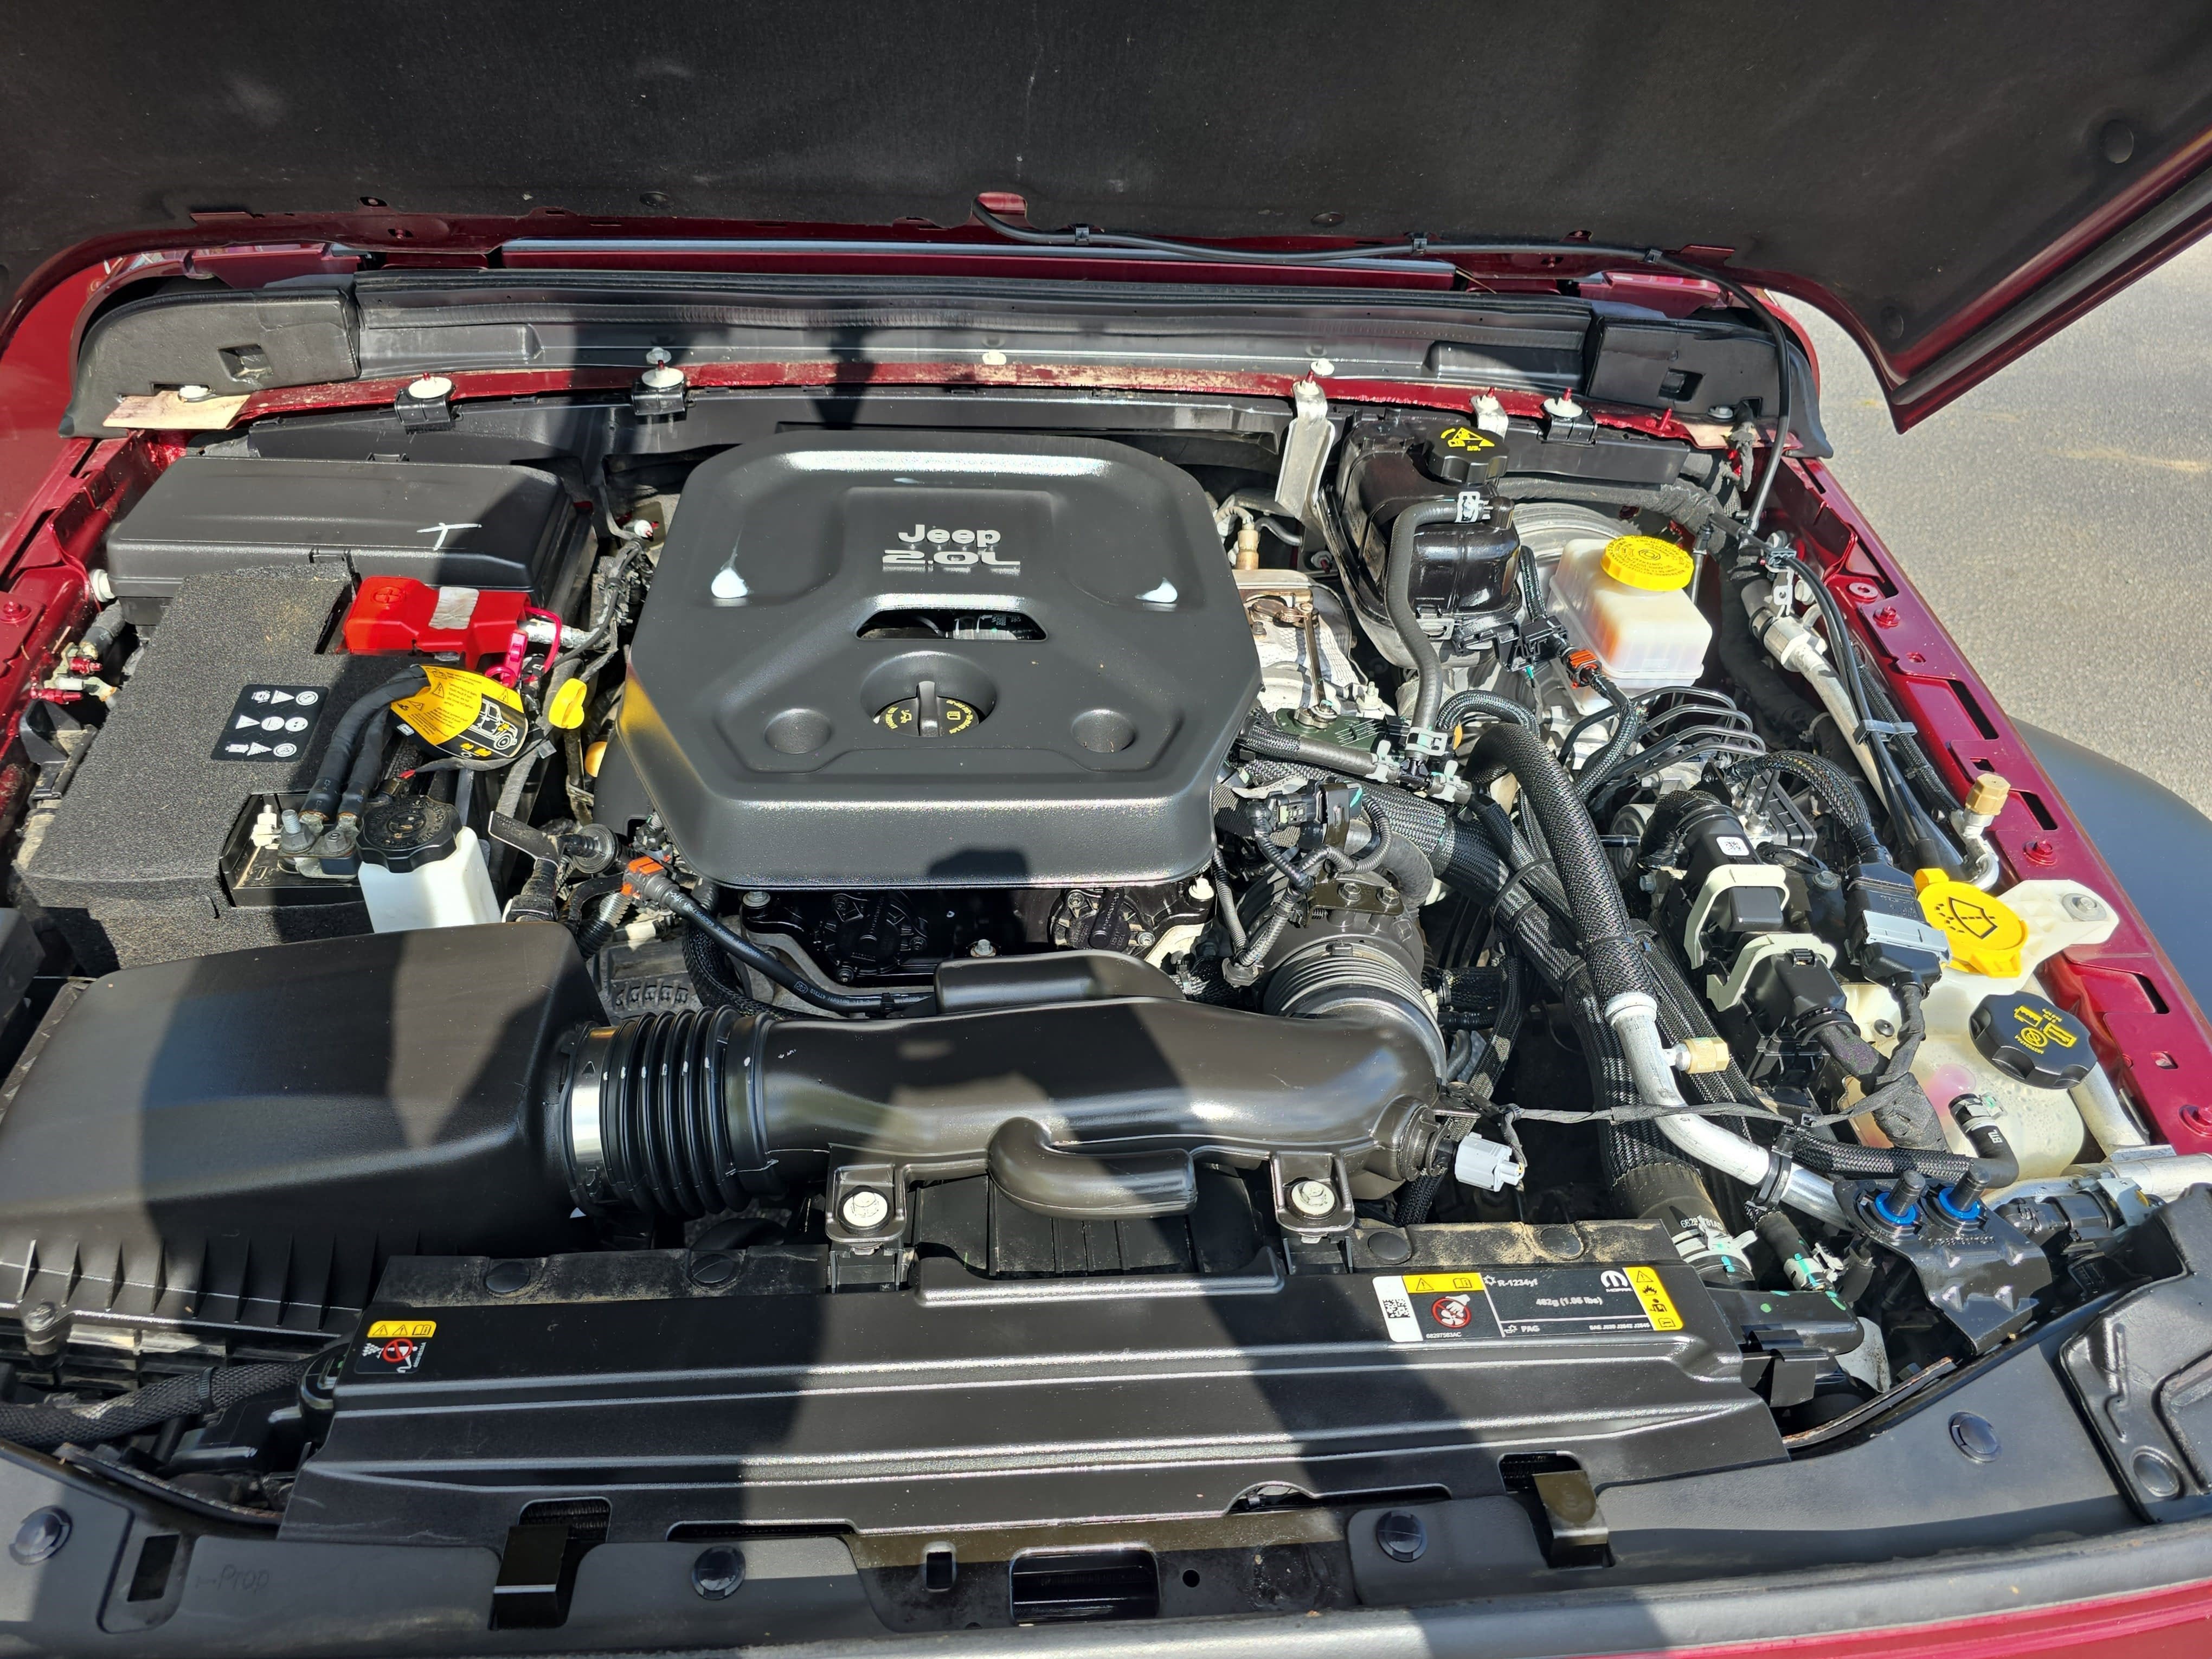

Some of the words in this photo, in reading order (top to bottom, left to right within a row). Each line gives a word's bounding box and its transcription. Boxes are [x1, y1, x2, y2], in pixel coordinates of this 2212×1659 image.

[898, 524, 1001, 548] Jeep
[883, 550, 1021, 565] 2.0L
[735, 938, 760, 959] VACUUM
[795, 982, 807, 992] CQC
[1496, 1278, 1539, 1288] R-1234yf
[1584, 1296, 1603, 1306] lbs)
